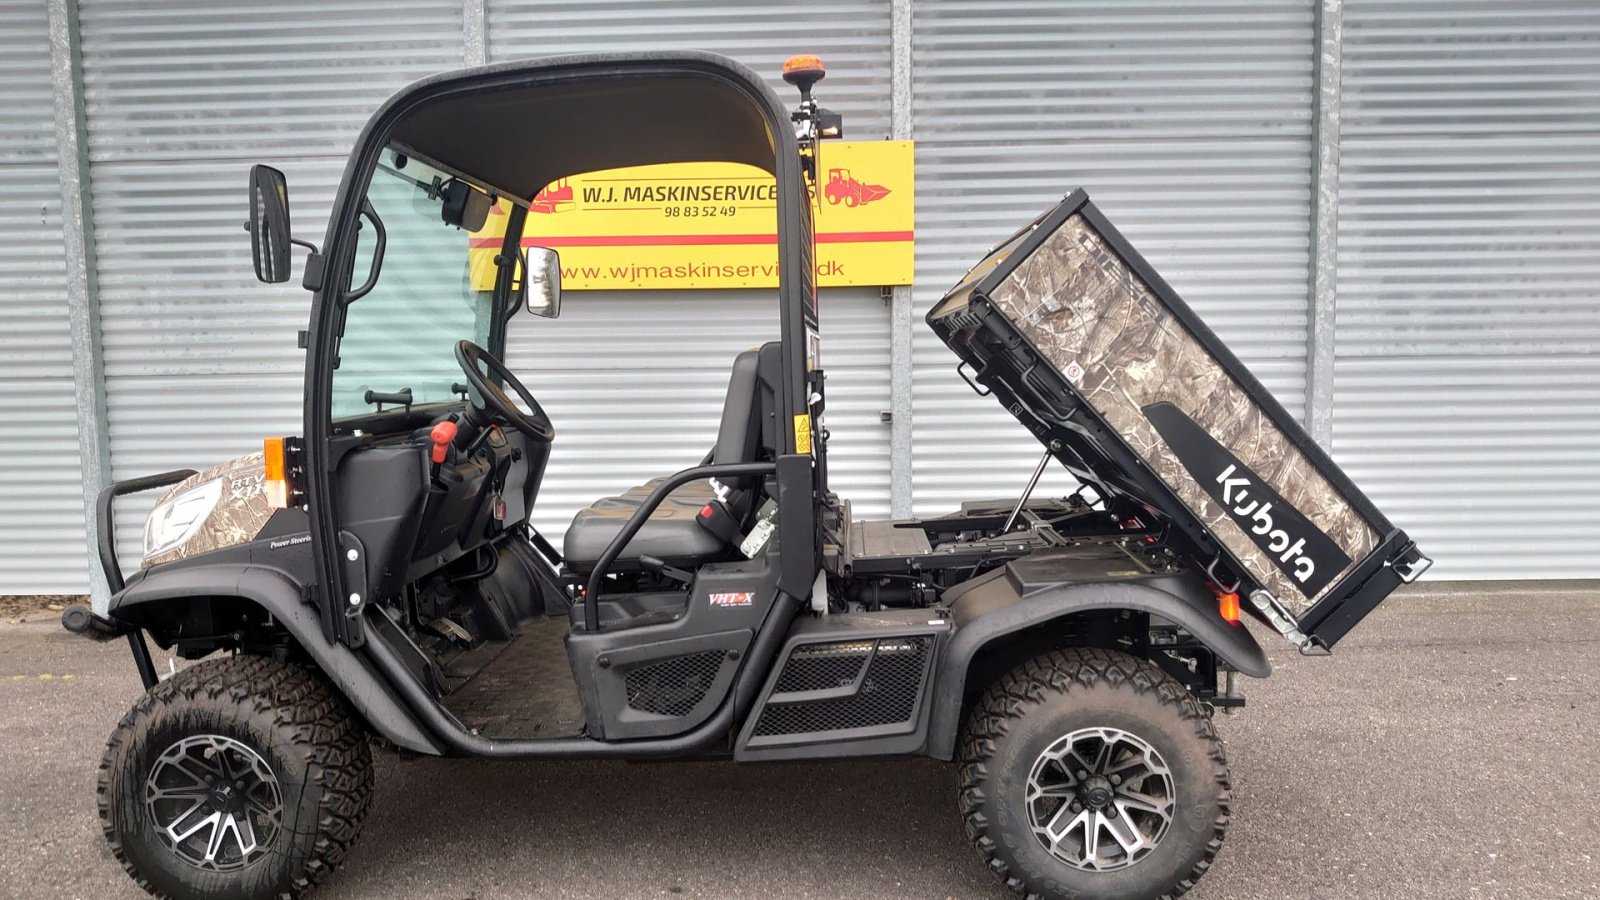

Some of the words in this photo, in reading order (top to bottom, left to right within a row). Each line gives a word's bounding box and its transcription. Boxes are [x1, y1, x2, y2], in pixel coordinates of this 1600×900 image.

[583, 187, 618, 203] W.J.
[623, 185, 777, 202] MASKINSERVICE
[664, 206, 681, 217] 98
[683, 206, 699, 217] 83
[702, 206, 717, 217] 52
[720, 205, 736, 216] 49
[1216, 464, 1315, 583] Kubota
[270, 541, 290, 549] Power
